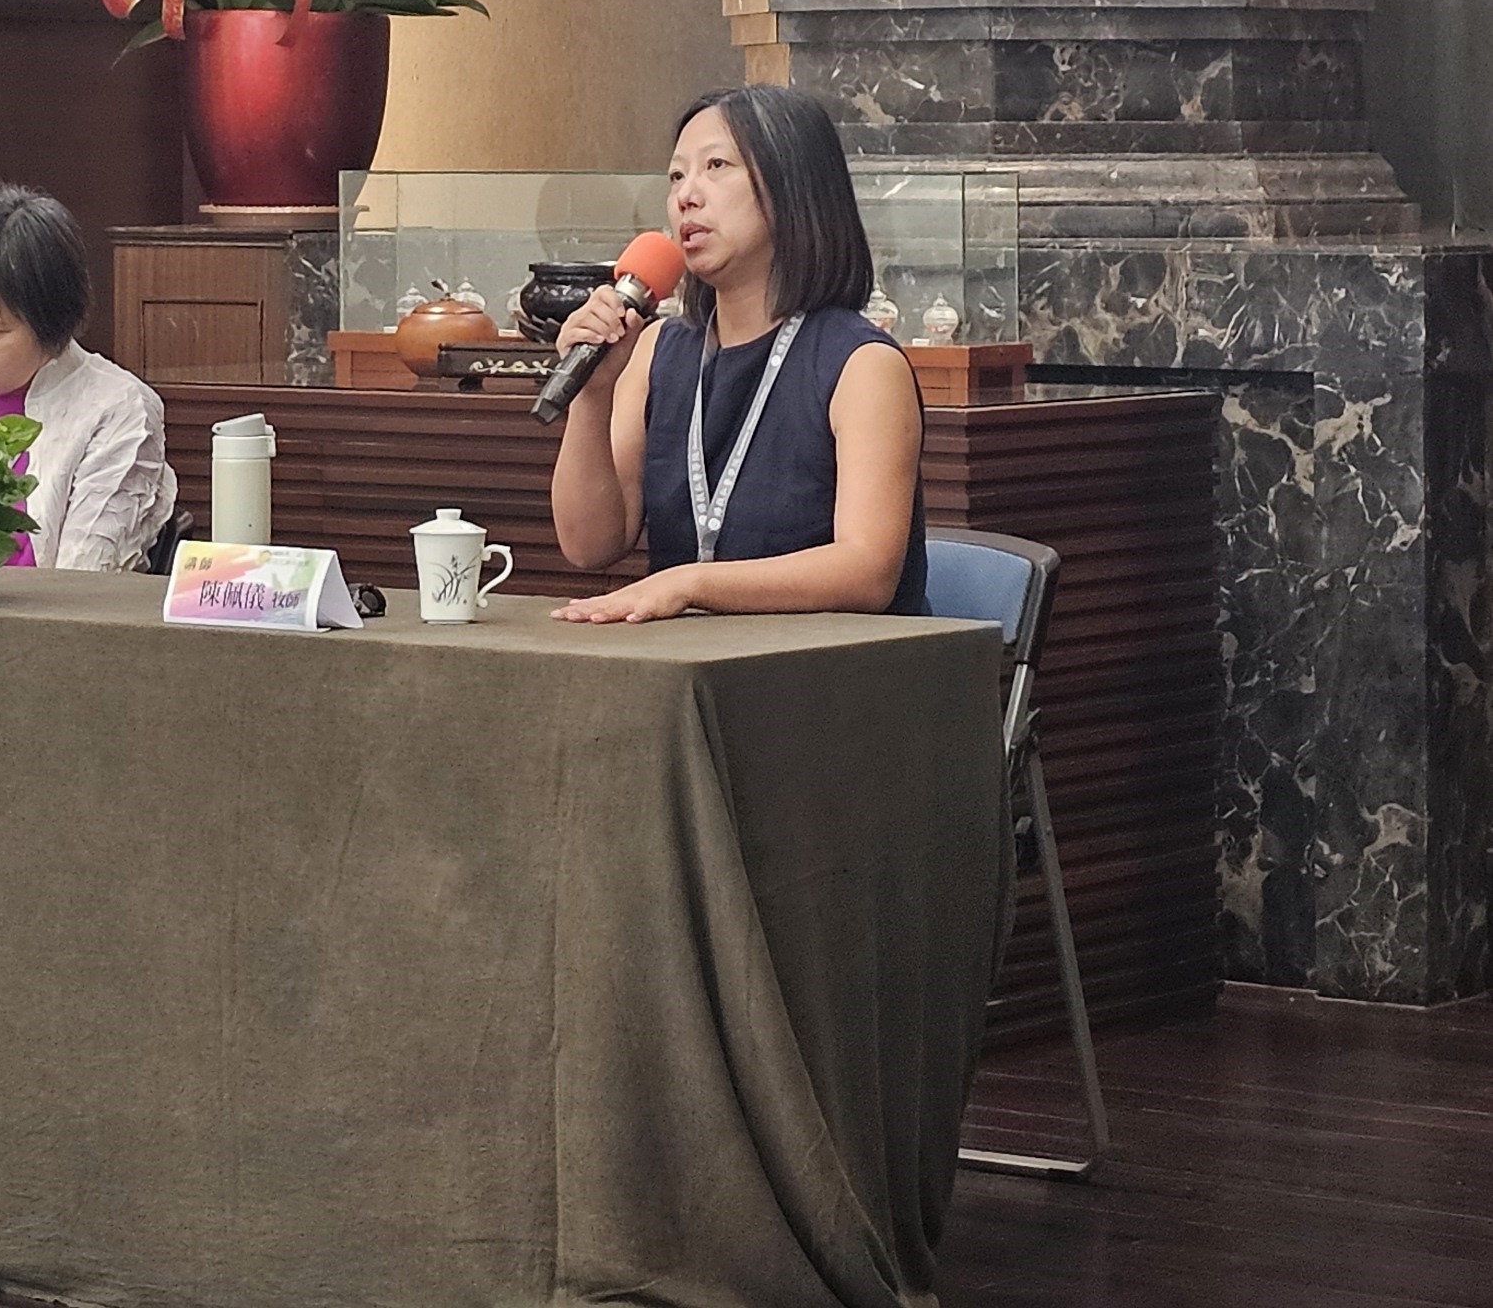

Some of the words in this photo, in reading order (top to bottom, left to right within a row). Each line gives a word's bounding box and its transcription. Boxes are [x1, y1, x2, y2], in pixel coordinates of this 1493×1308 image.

[199, 580, 266, 611] 陳佩儀
[272, 591, 301, 609] 牧師
